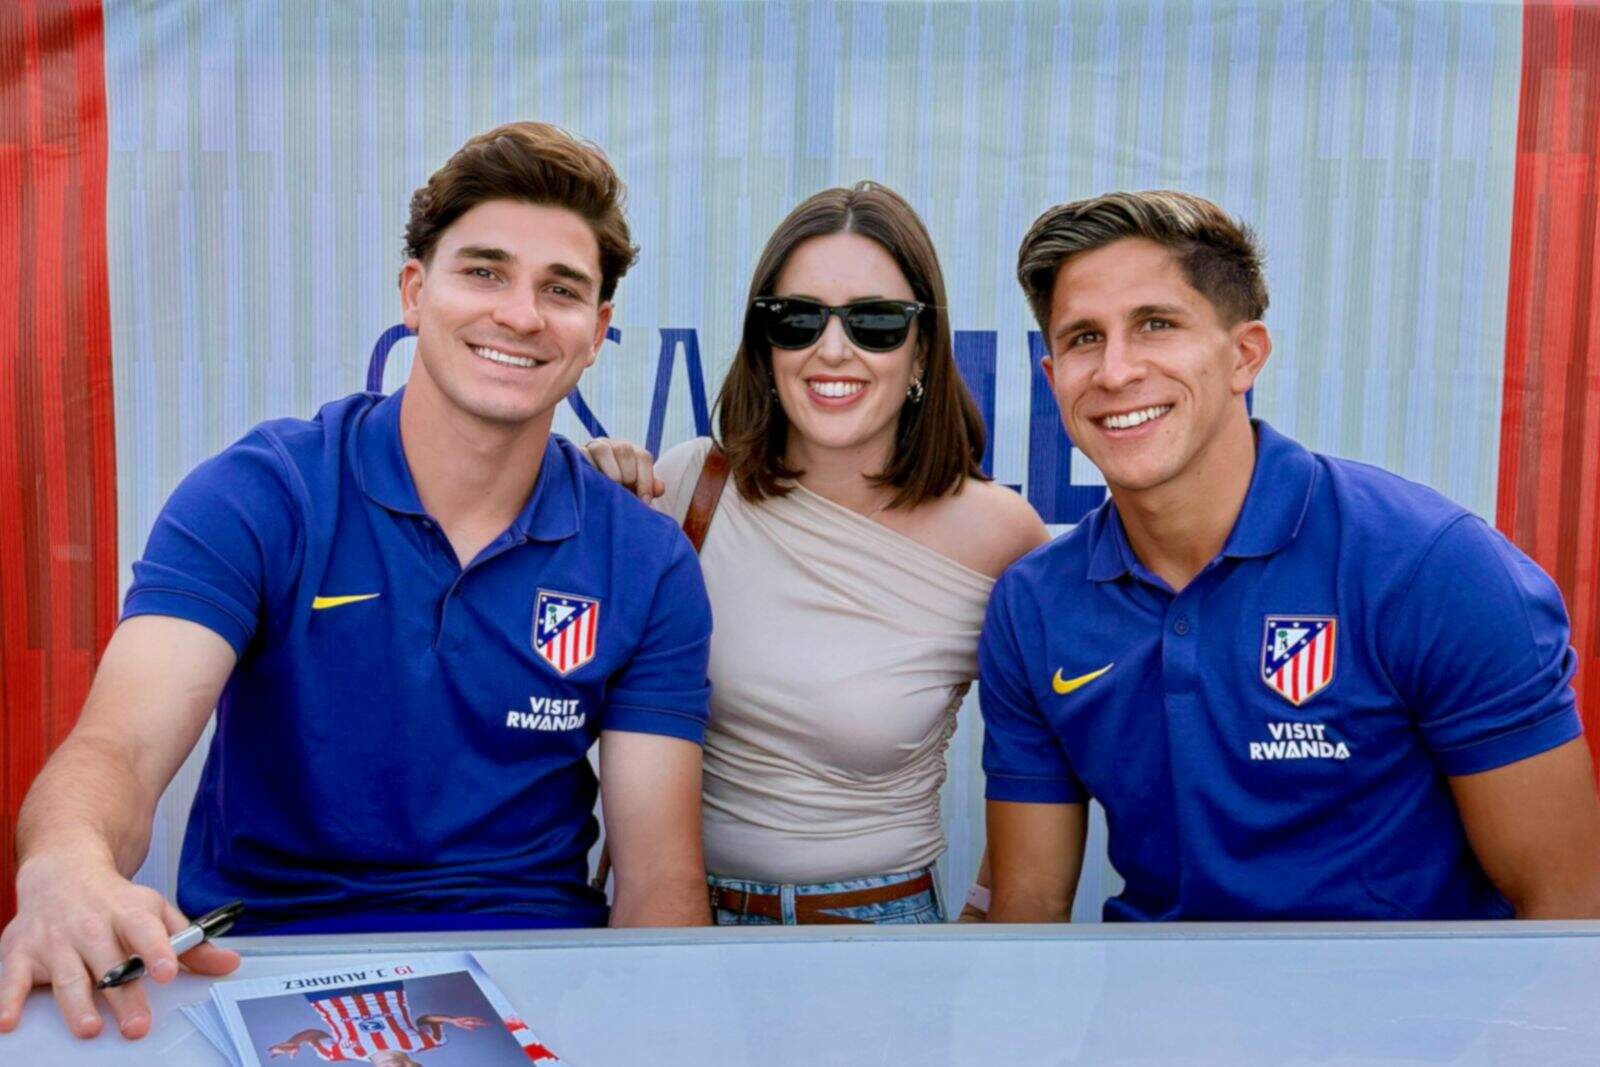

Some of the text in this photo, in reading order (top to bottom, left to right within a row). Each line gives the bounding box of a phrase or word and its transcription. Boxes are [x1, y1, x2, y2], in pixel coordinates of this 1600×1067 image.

[529, 696, 580, 715] VISIT
[1267, 722, 1325, 740] VISIT
[1250, 741, 1351, 760] RWANDA
[283, 965, 415, 990] 19 J. ALVAREZ
